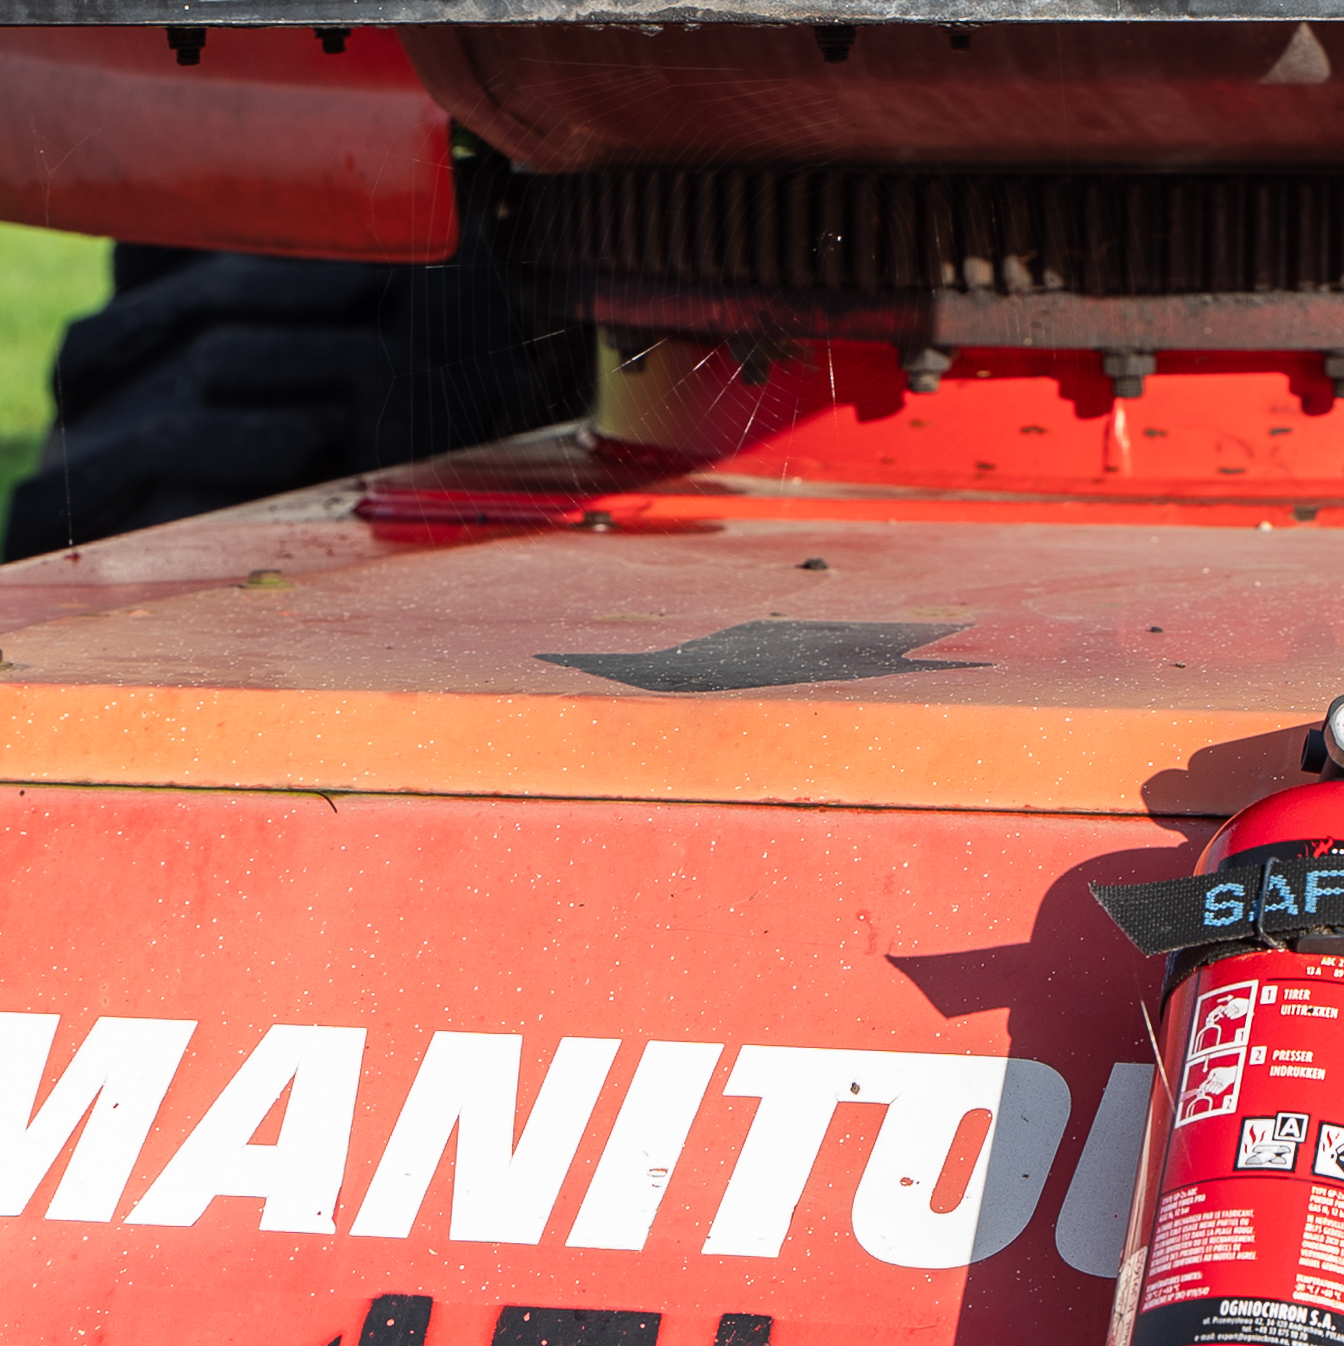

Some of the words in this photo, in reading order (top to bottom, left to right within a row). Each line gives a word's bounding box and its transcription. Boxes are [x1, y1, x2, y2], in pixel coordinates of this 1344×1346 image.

[1283, 988, 1312, 1001] TIRER
[1272, 1049, 1314, 1063] PRESSER
[1269, 1065, 1327, 1081] INDRUKKEN
[1280, 1117, 1301, 1138] A
[1219, 1299, 1308, 1324] OGNIOCHRON
[1308, 1309, 1337, 1331] S.A.
